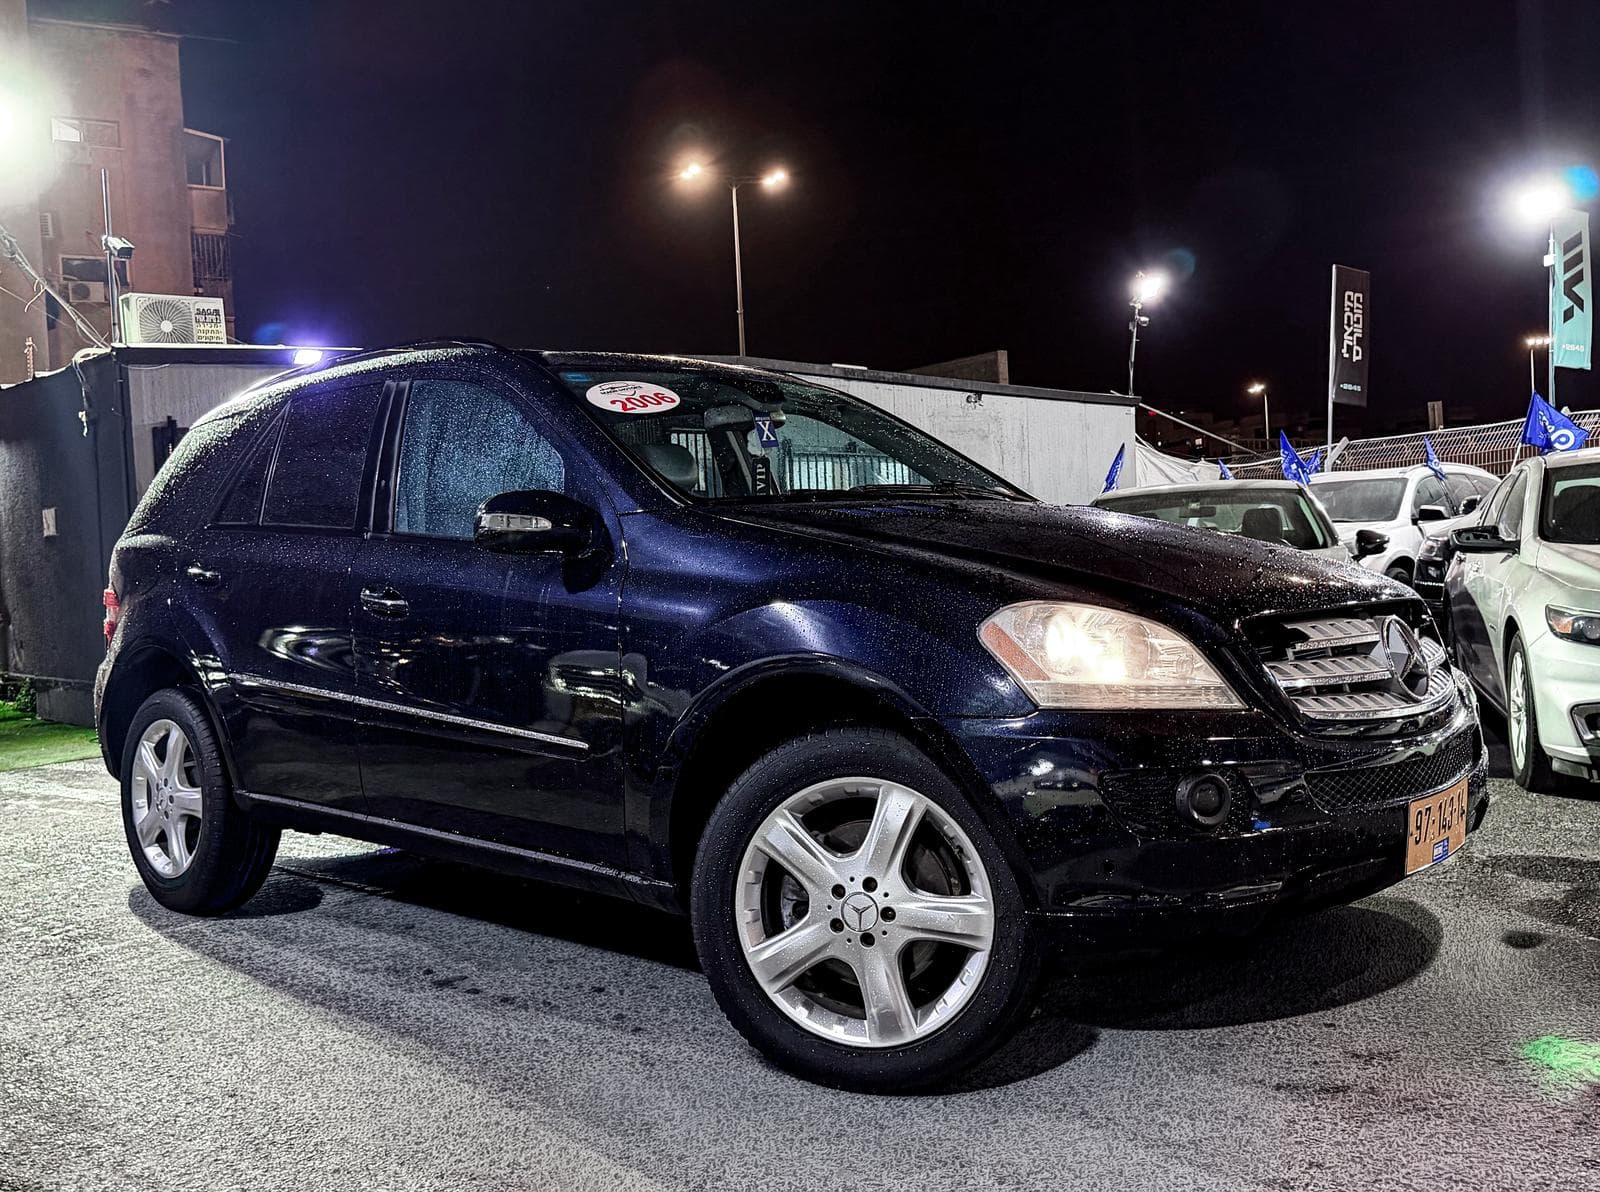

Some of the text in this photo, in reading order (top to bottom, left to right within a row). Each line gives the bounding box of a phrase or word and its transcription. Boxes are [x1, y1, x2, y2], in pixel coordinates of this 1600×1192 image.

[1341, 290, 1354, 358] מיכאלי
[1353, 292, 1363, 362] מוטורס
[610, 392, 676, 411] 2006
